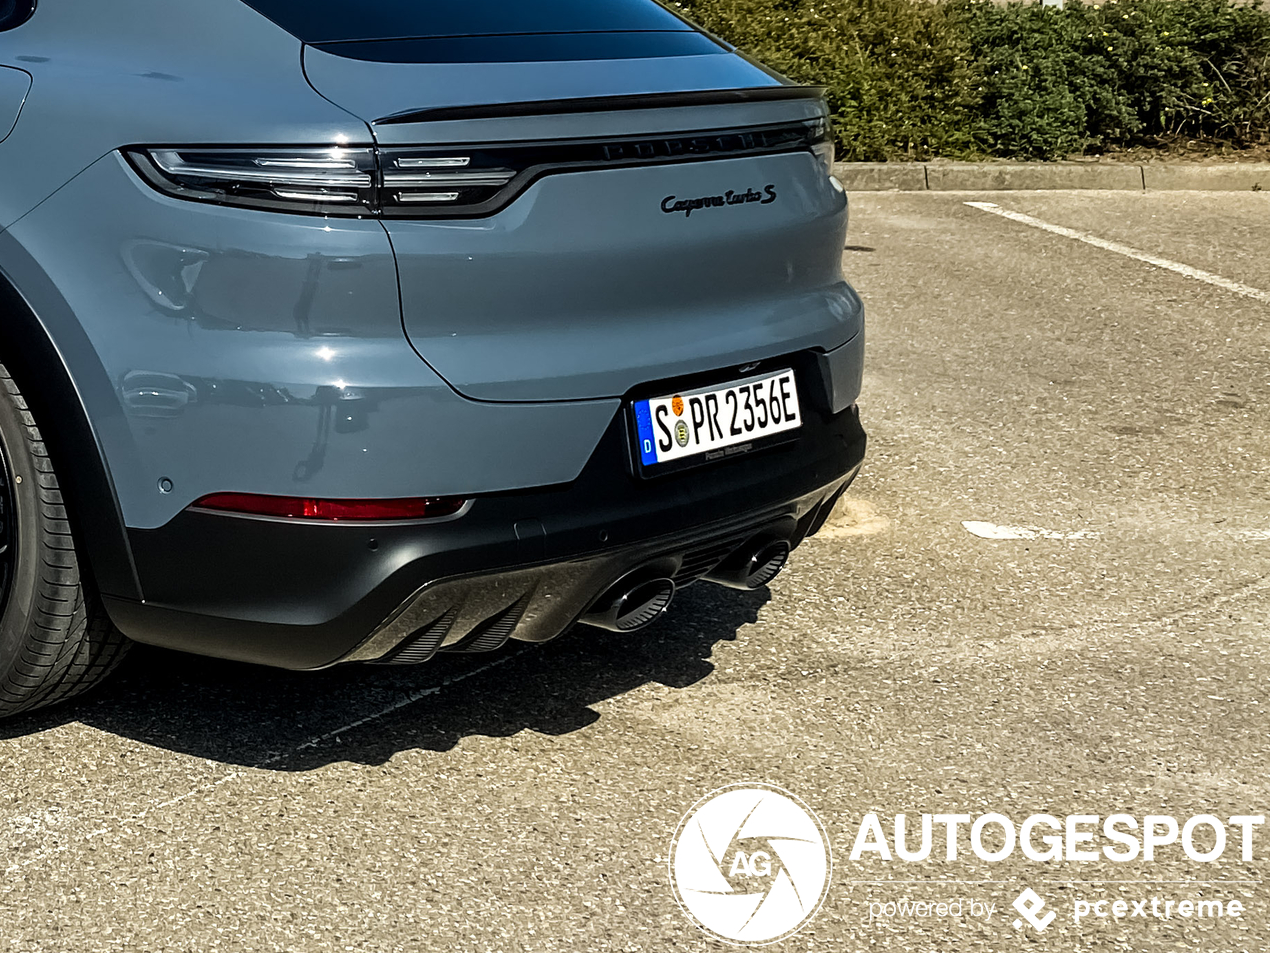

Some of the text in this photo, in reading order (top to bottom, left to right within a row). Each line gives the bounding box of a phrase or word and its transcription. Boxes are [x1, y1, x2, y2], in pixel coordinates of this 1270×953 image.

[660, 195, 725, 217] Cayenne
[760, 184, 776, 204] S
[655, 376, 796, 452] S PR 2356E
[643, 439, 652, 453] D
